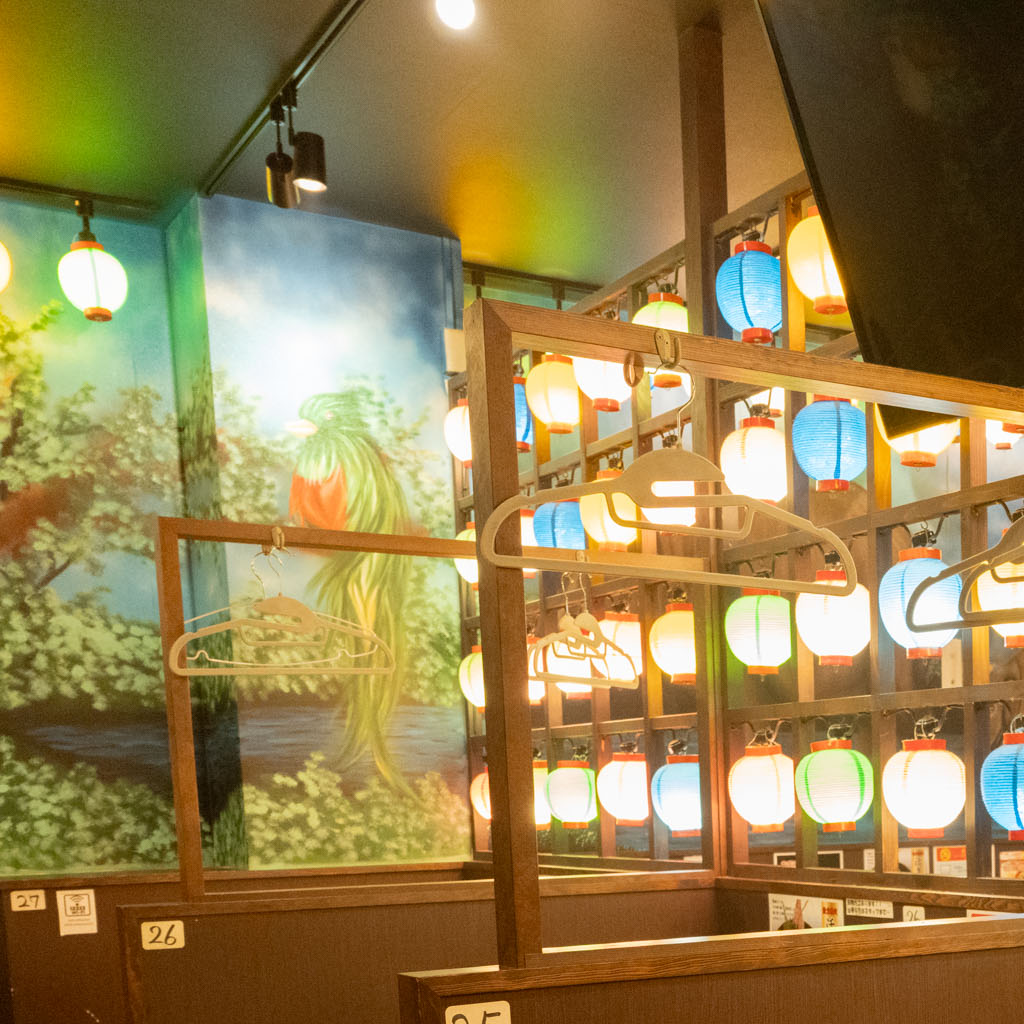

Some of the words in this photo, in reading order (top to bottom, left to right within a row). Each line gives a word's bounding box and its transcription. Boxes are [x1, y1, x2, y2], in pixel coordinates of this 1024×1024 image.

[16, 895, 39, 908] 27
[907, 909, 922, 921] 26
[149, 924, 176, 945] 26
